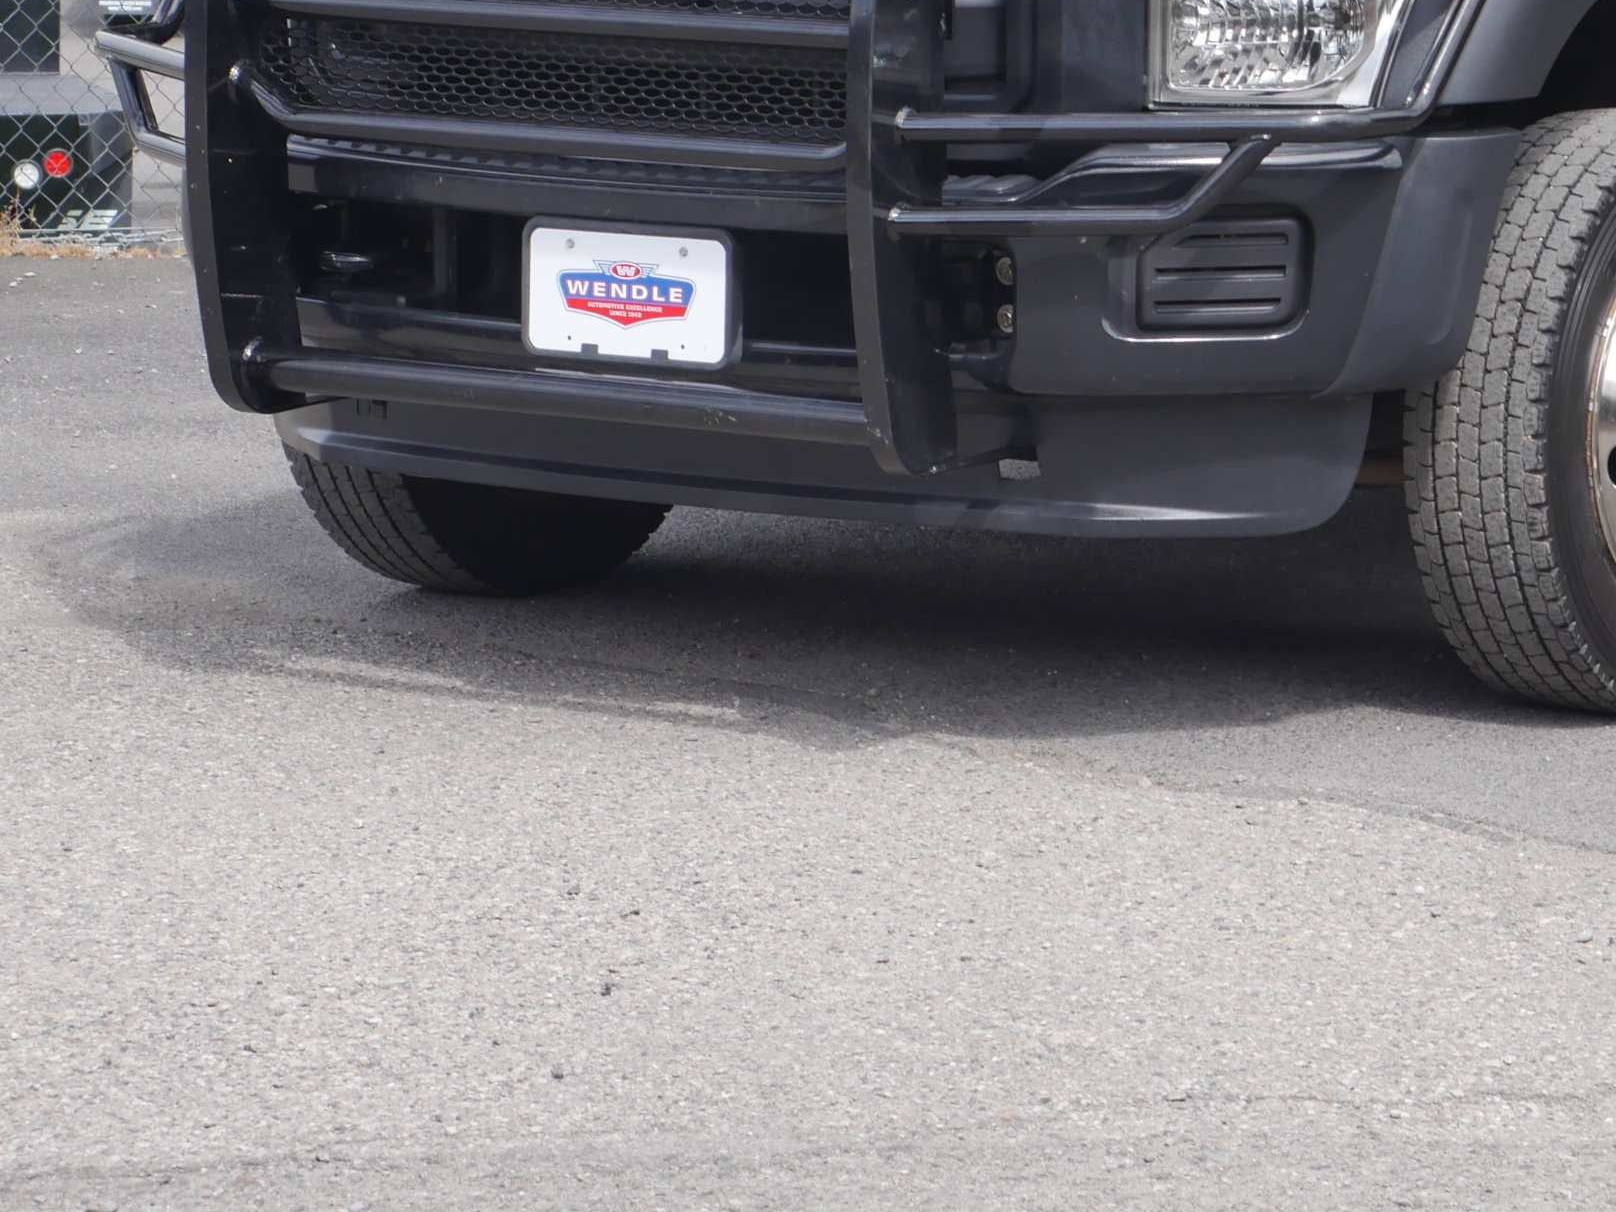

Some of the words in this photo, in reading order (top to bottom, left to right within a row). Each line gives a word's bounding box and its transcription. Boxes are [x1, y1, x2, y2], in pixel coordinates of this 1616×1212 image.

[566, 279, 683, 303] WENDLE
[587, 301, 625, 311] AUTOMOTIVE
[625, 304, 663, 313] EXCELLENCE
